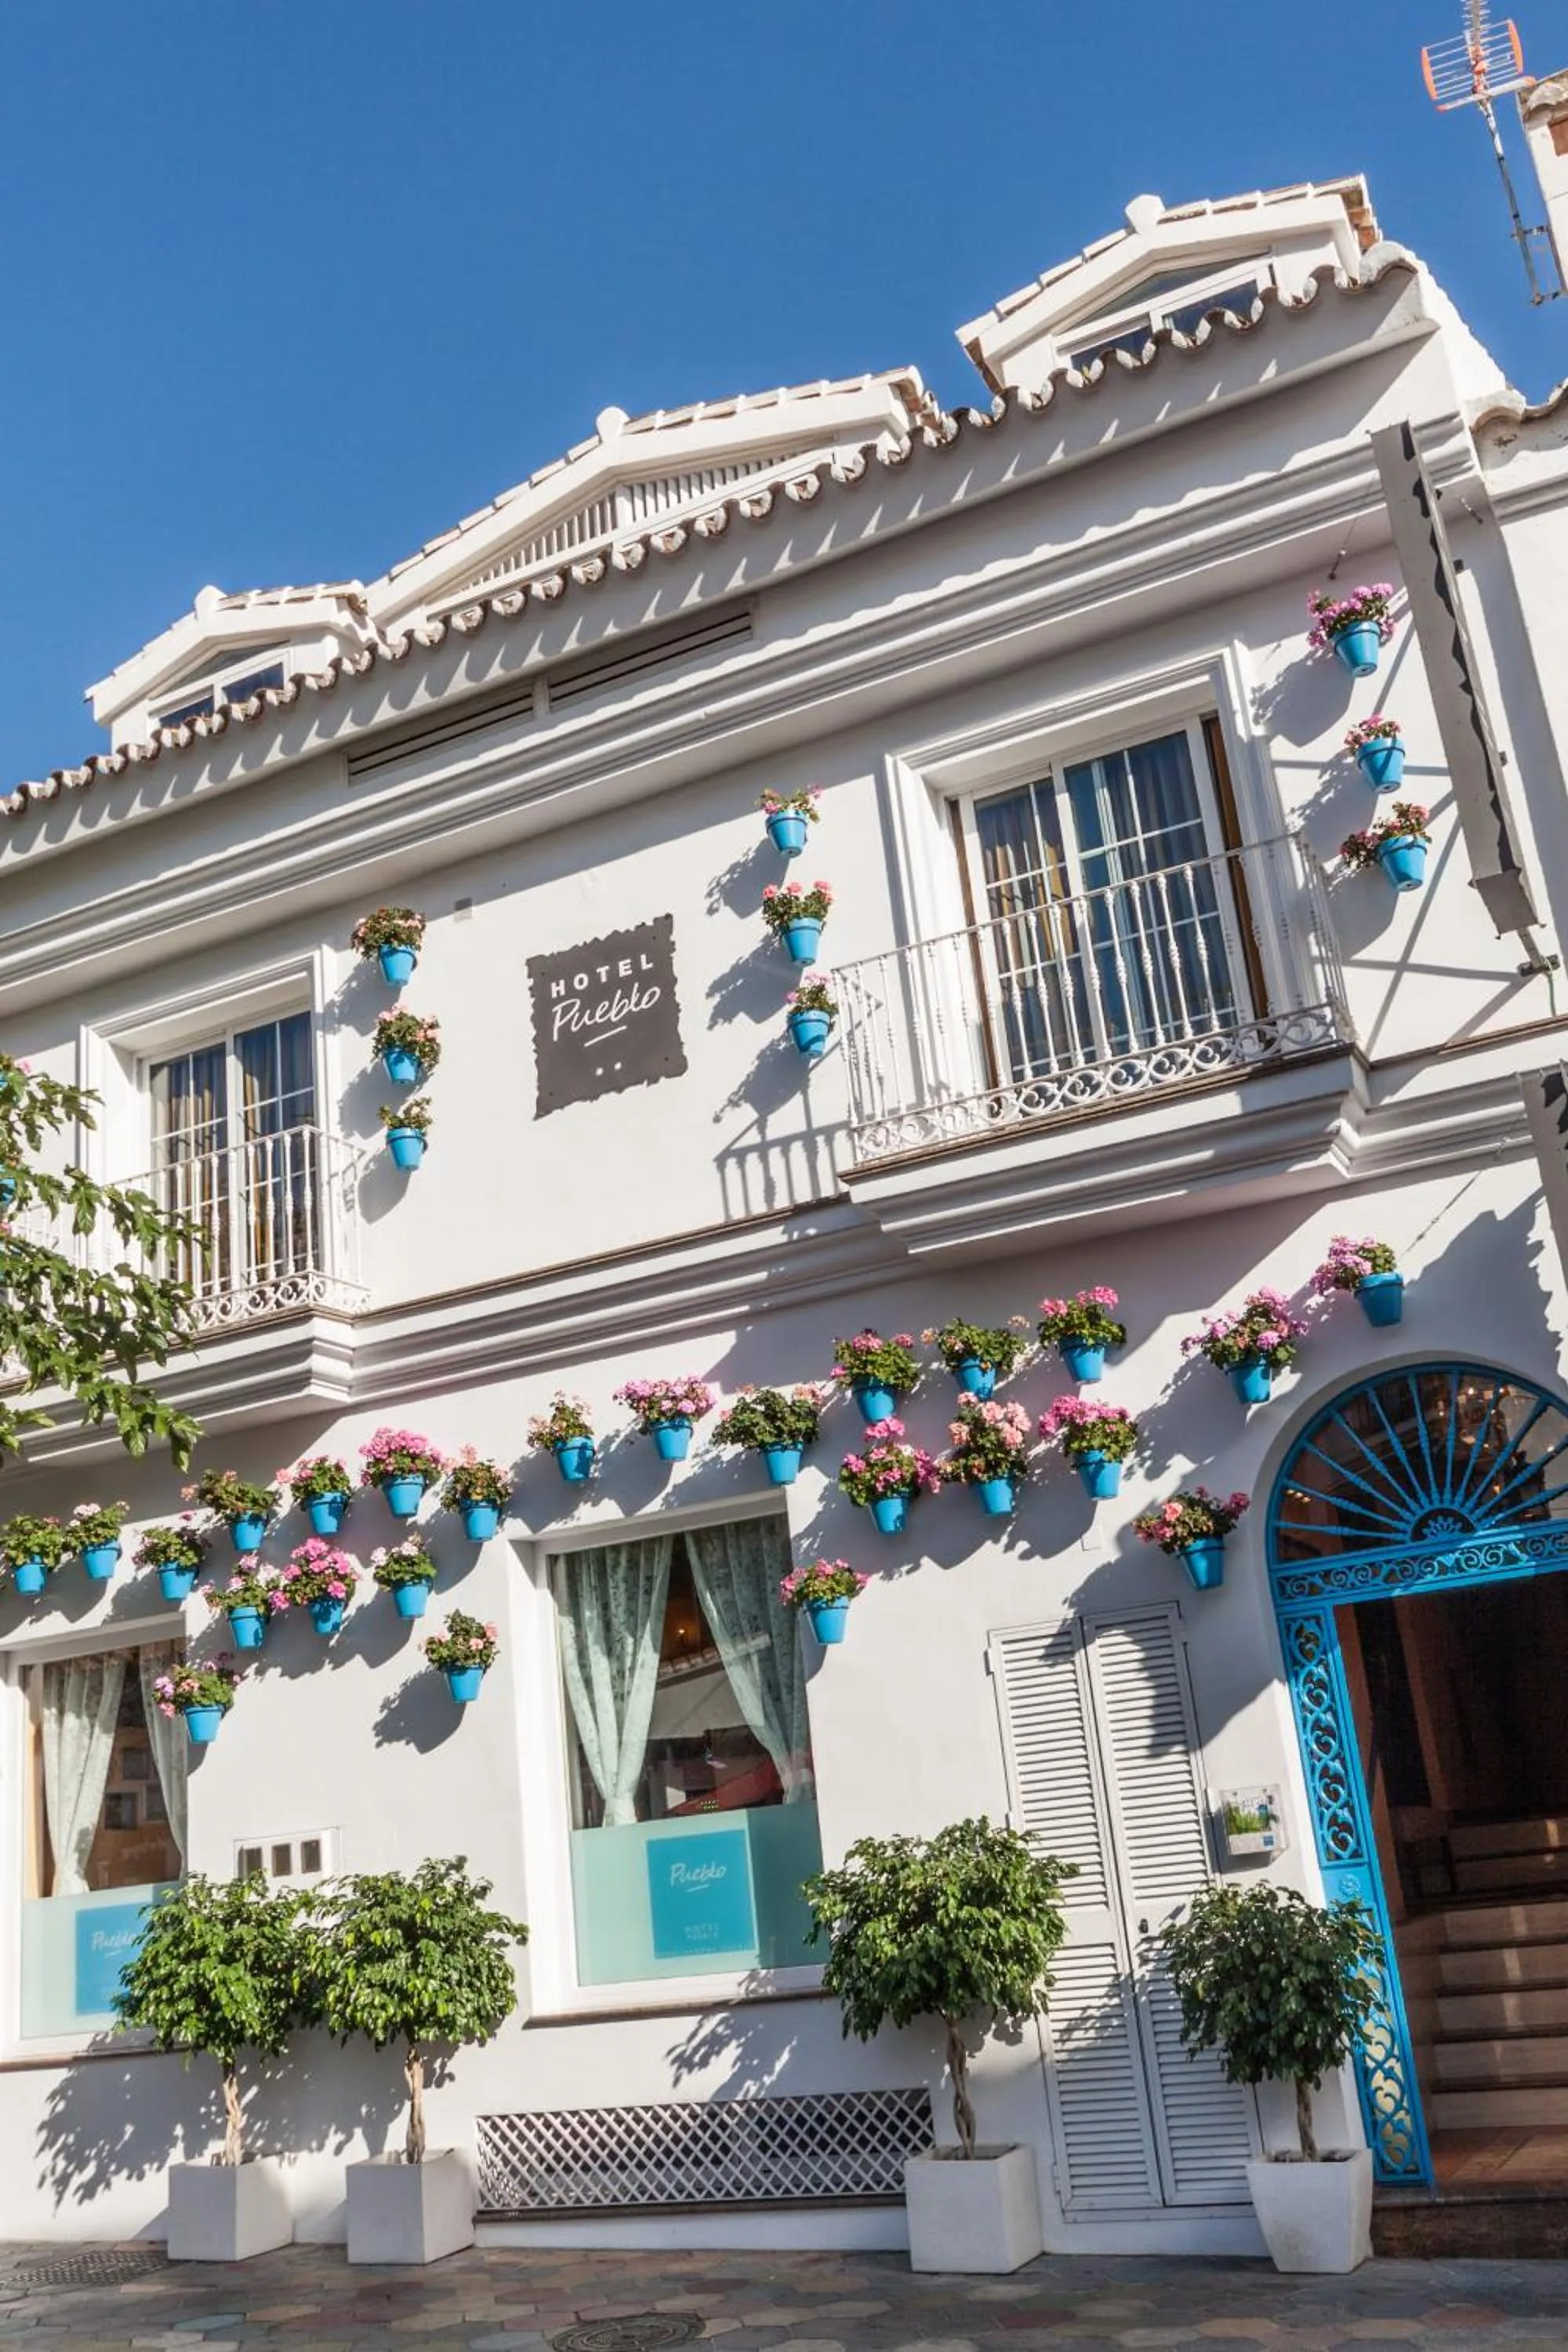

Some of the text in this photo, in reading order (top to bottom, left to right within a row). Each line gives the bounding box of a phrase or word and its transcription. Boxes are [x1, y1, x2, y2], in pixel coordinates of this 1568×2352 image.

[551, 954, 653, 998] HOTEL
[551, 982, 661, 1041] Pueblo
[670, 1862, 727, 1886] Pueblo
